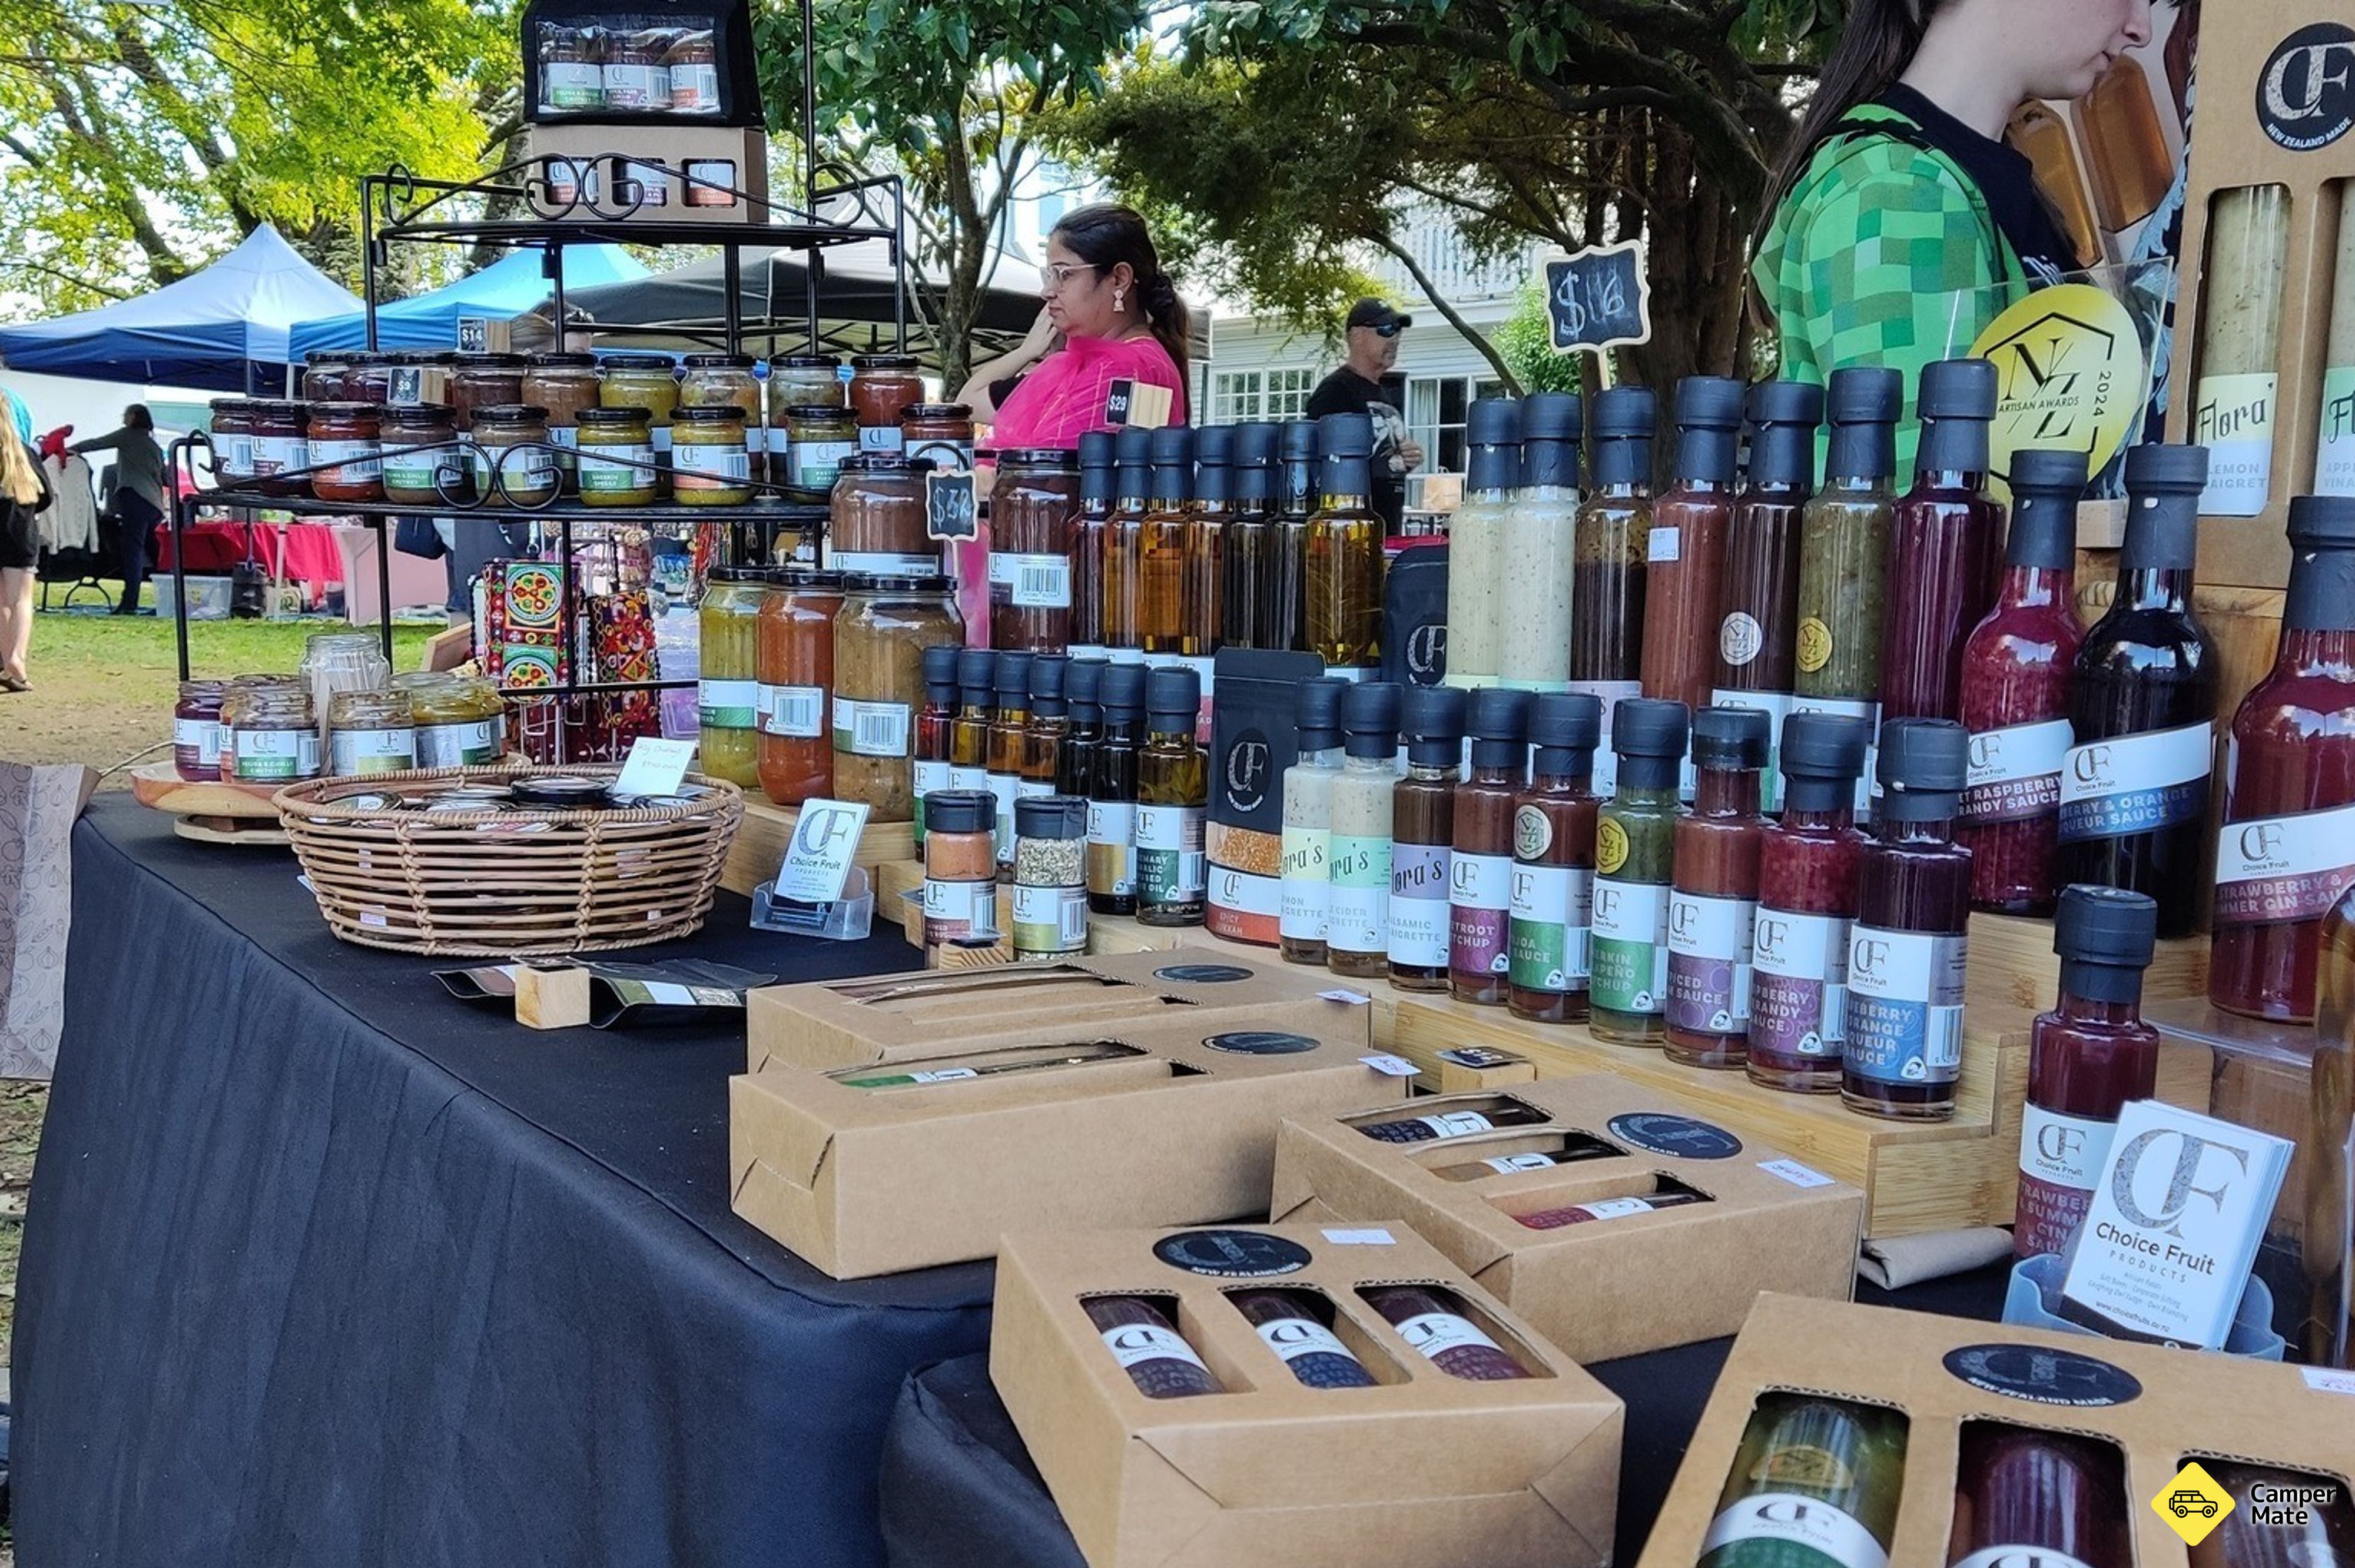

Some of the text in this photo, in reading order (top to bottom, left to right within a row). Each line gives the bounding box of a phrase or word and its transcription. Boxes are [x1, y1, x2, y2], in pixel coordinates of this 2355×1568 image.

[2267, 115, 2353, 148] NEW ZEALAND MADE
[462, 328, 483, 343] $14
[397, 380, 412, 391] $9
[2093, 370, 2112, 417] 2024
[1998, 396, 2080, 413] ARTISAN AWARDS
[2198, 383, 2273, 447] Flora'
[2209, 463, 2260, 475] EMON
[2326, 462, 2355, 473] APP
[2207, 477, 2267, 489] AIGRET
[1228, 741, 1269, 792] CF
[2075, 745, 2112, 782] CF
[1959, 776, 2062, 803] ET RASPBERRY
[1959, 790, 2059, 816] RANDY SAUCE
[2061, 788, 2190, 819] BERRY & ORANGE
[2061, 805, 2168, 833] QUEUR SAUCE
[797, 808, 857, 858] CF
[2240, 822, 2286, 861] CF
[790, 856, 841, 871] Choice Fruit
[1141, 855, 1169, 865] MARY
[1283, 836, 1323, 876] ora's
[1329, 842, 1369, 882] ora's
[2243, 861, 2290, 872] Choice Fruit
[1392, 851, 1443, 892] ora's
[1452, 861, 1480, 890] CF
[2218, 874, 2343, 899] STRAWBERRY &
[1281, 905, 1324, 918] GRETTE
[1282, 895, 1304, 906] MON
[1594, 888, 1621, 920] CF
[2264, 895, 2298, 912] GIN
[2304, 888, 2344, 906] SAU
[1391, 916, 1432, 930] LSAMIC
[1451, 921, 1495, 936] TROOT
[1671, 902, 1700, 935] CF
[1391, 928, 1441, 942] IGRETTE
[1452, 935, 1491, 948] TCHUP
[1514, 936, 1536, 950] JOA
[1756, 918, 1789, 955] CF
[1854, 938, 1890, 975] CF
[1669, 971, 1701, 989] ICED
[1676, 988, 1723, 1005] SAUCE
[1756, 984, 1810, 1005] PBERRY
[1753, 997, 1800, 1019] RANDY
[1850, 999, 1913, 1022] EBERRY
[1848, 1031, 1896, 1051] QUEUR
[2037, 1124, 2087, 1164] CF
[2035, 1158, 2084, 1177] Choice Fruit
[2111, 1128, 2250, 1240] CF
[2027, 1202, 2085, 1227] SUMM
[2036, 1222, 2068, 1243] GIN
[2097, 1222, 2215, 1277] Choice Fruit
[2109, 1250, 2187, 1284] PRODUCTS
